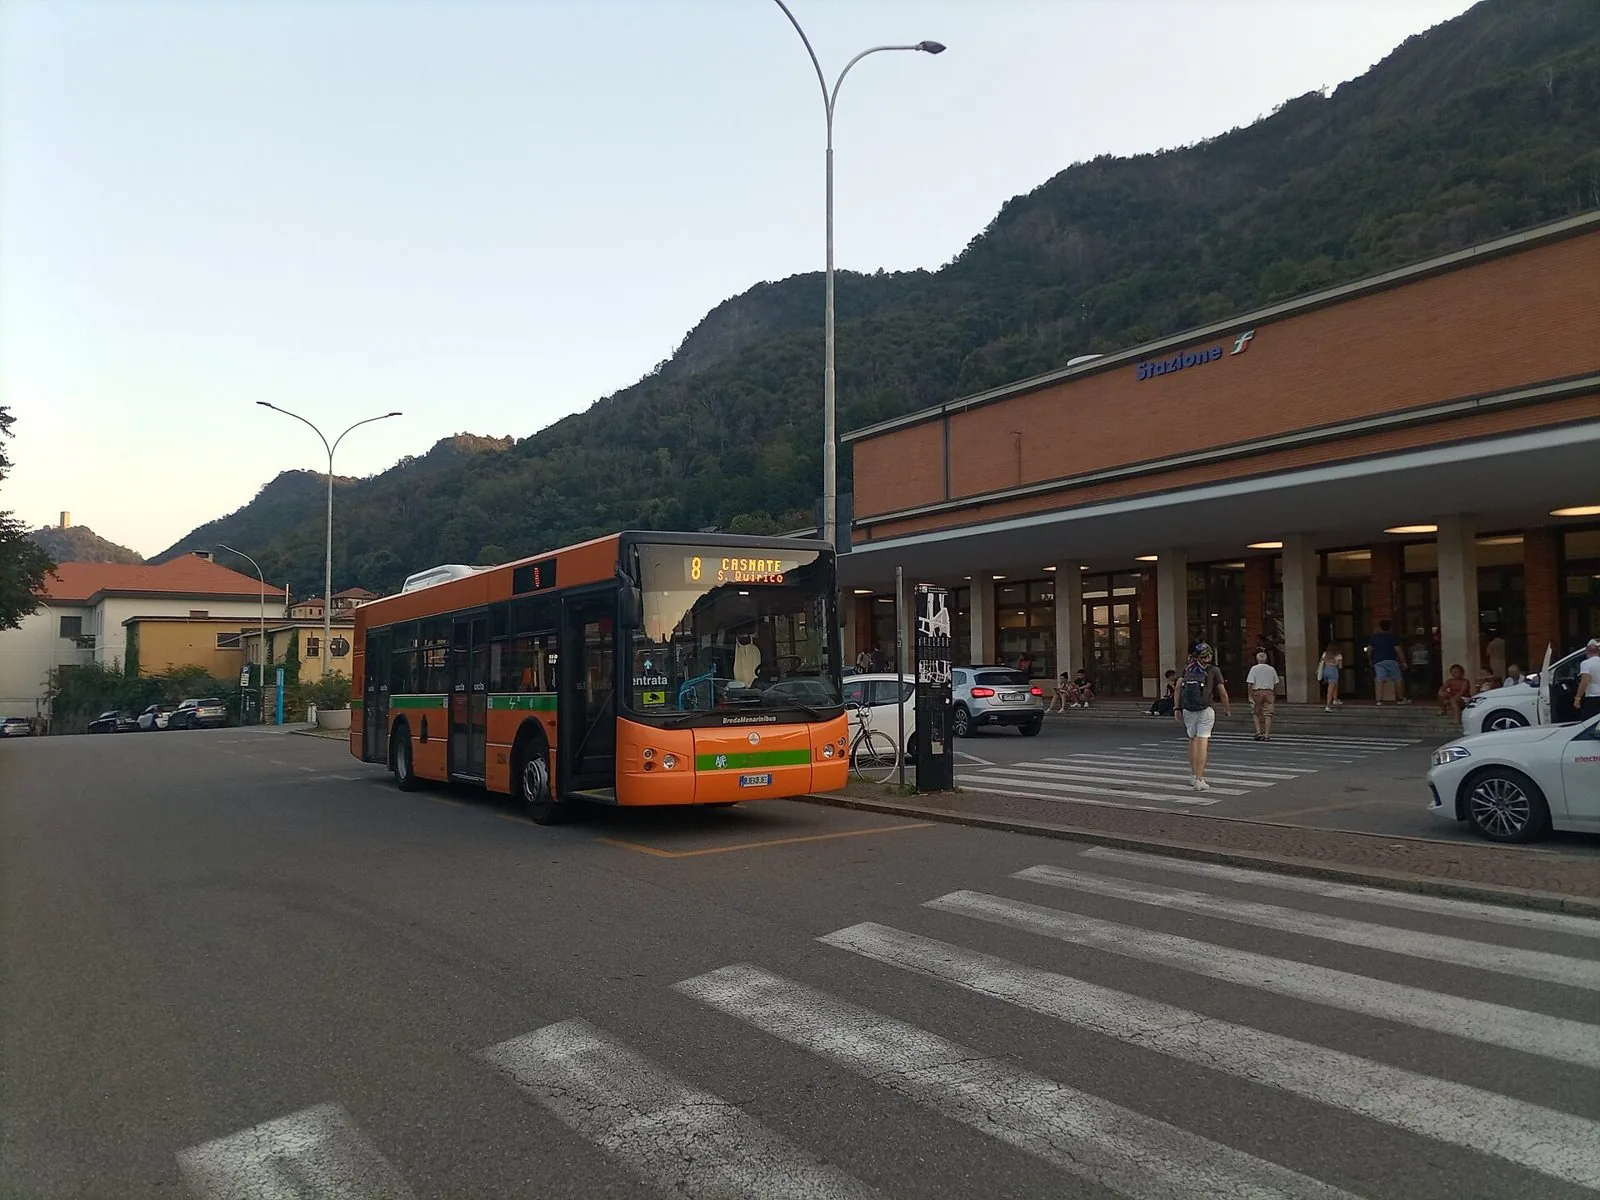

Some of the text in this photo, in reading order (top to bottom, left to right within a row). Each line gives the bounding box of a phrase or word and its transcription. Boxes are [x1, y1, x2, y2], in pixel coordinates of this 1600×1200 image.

[1136, 346, 1222, 380] Stazione
[691, 557, 701, 581] 8
[722, 558, 781, 572] CASNATE
[735, 571, 784, 583] Quirico
[632, 676, 667, 686] entrata
